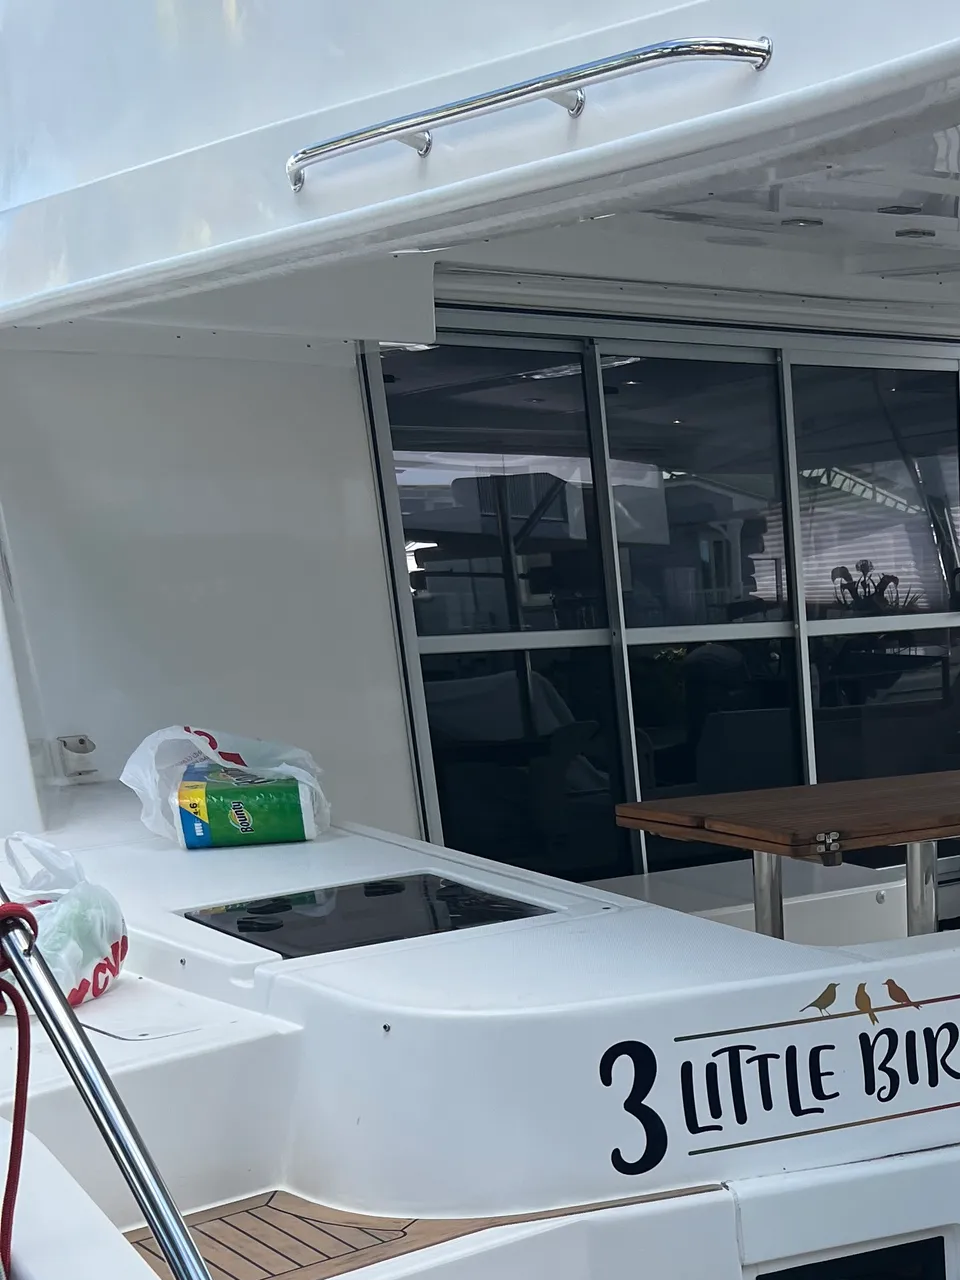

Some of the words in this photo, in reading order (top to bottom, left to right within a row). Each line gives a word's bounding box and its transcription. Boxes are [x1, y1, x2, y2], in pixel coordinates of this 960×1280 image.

[231, 801, 254, 834] Bounty
[600, 1040, 668, 1175] 3
[681, 1044, 840, 1134] LITTLE
